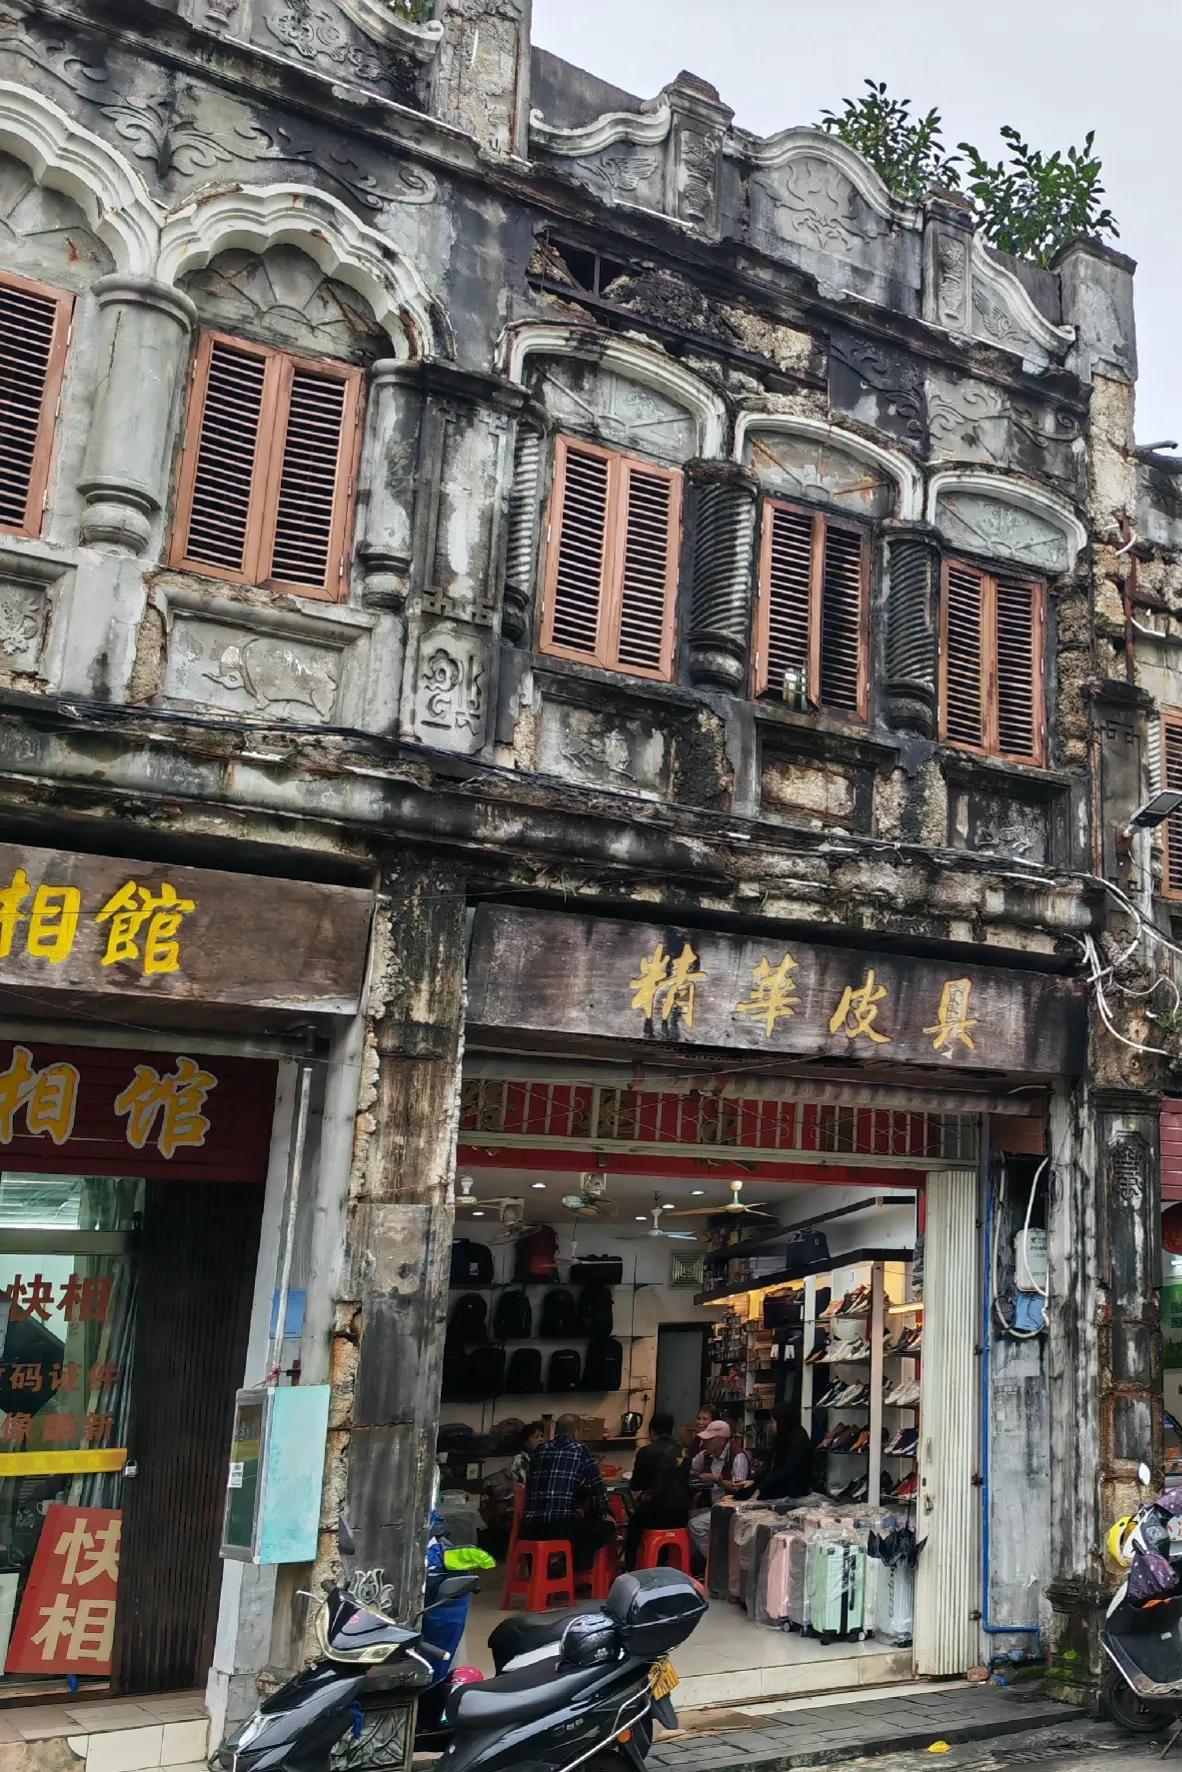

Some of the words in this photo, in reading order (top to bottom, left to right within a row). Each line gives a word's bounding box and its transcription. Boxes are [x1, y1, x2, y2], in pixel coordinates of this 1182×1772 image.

[0, 867, 197, 976] 相館
[629, 941, 979, 1051] 精華皮具
[0, 1045, 218, 1159] 相馆
[4, 1273, 112, 1322] 快相
[0, 1361, 121, 1393] 码证件
[30, 1518, 123, 1662] 快相
